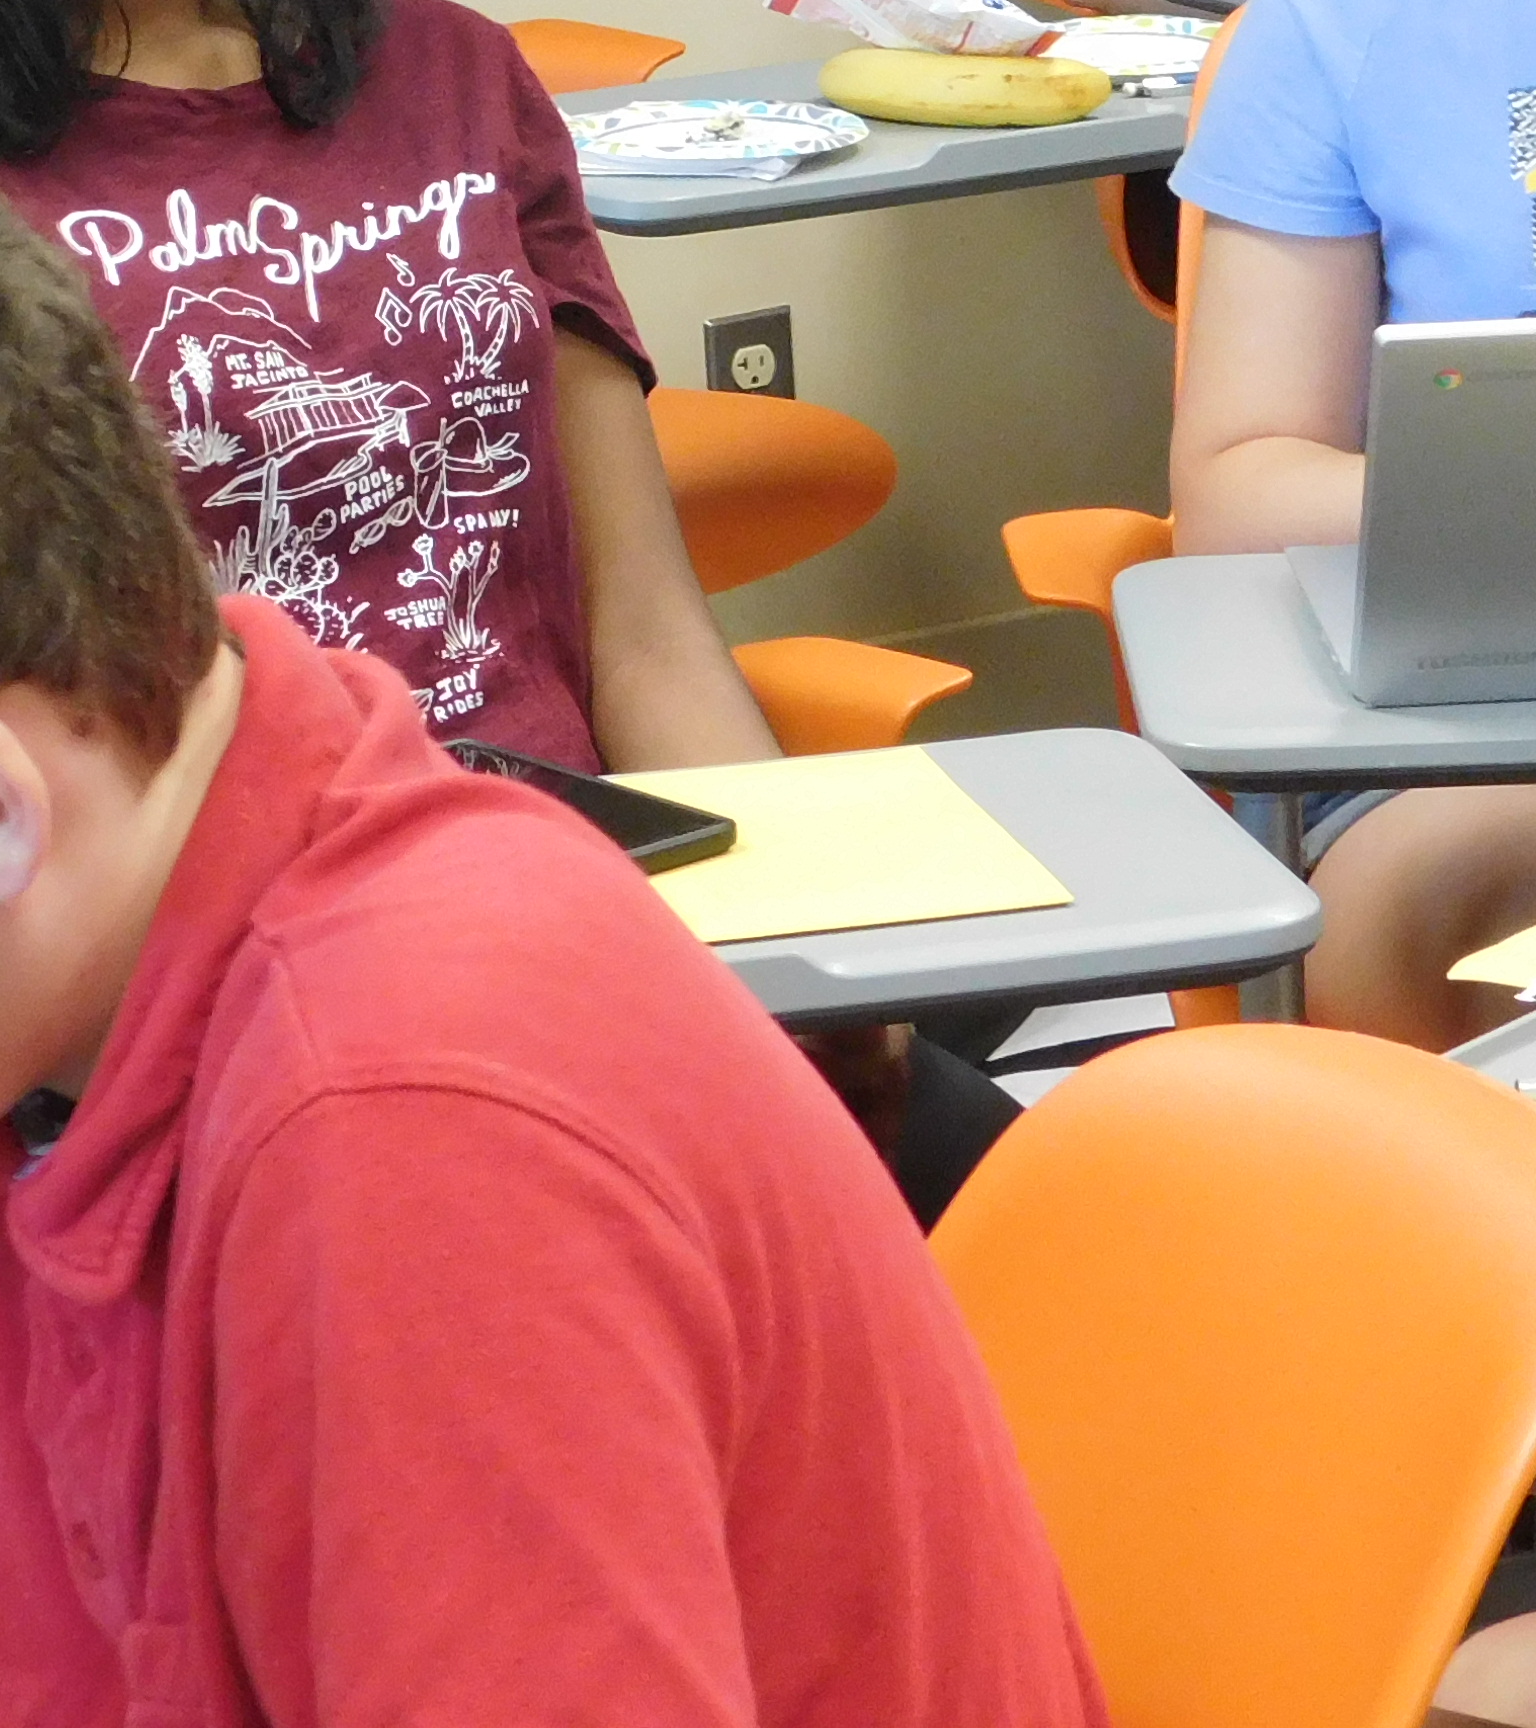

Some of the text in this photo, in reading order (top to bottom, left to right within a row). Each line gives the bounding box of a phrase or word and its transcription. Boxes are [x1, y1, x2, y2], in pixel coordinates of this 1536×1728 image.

[57, 171, 496, 323] Palm Springs
[225, 351, 285, 371] MT. SAN
[230, 366, 309, 389] JACINTO
[451, 379, 530, 409] COACHELLA
[474, 398, 522, 417] VALLEY
[340, 474, 406, 524] PARTIES
[344, 466, 393, 502] POOL
[384, 596, 446, 621] JOSHUA
[396, 611, 445, 630] TREE
[435, 666, 478, 701] JOY
[433, 691, 484, 723] RIDES
